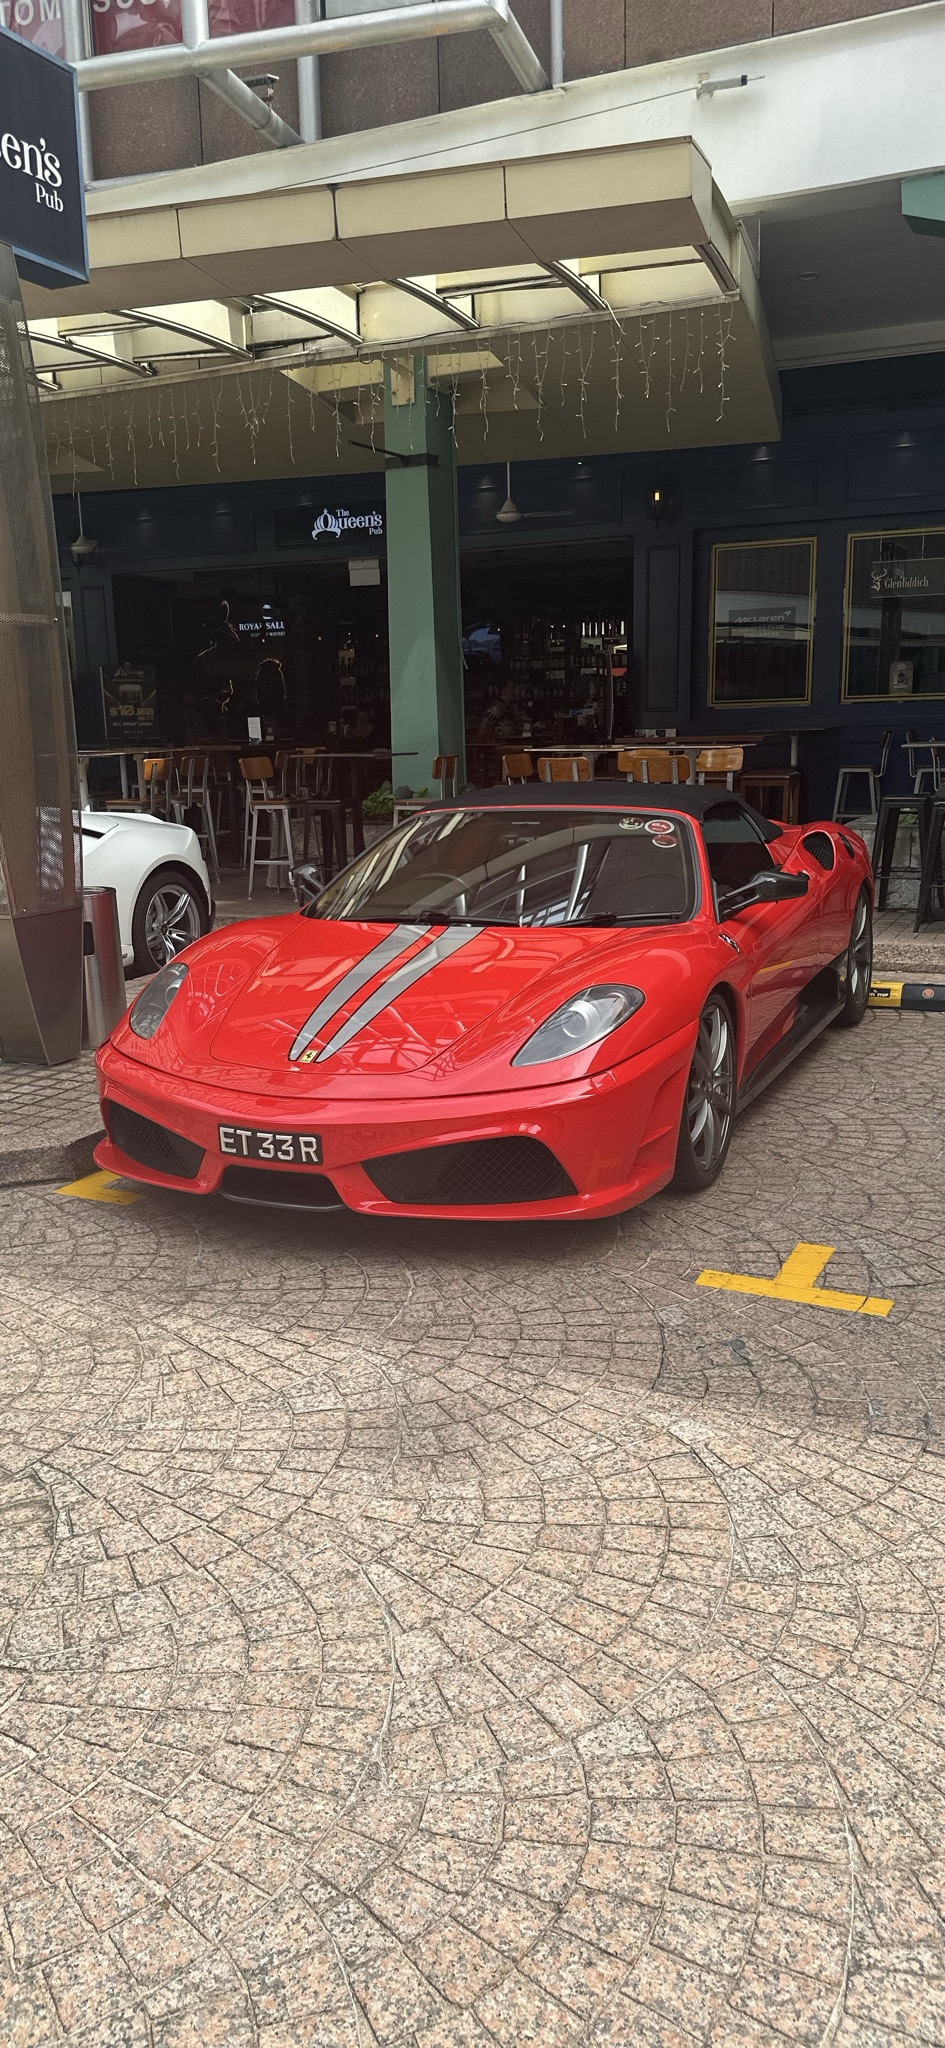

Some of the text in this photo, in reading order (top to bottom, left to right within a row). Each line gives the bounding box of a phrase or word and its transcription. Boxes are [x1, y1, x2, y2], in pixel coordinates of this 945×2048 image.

[0, 133, 62, 187] en's
[35, 182, 64, 212] Pub
[336, 509, 350, 517] The
[312, 508, 383, 540] Queen's
[369, 527, 383, 535] Pub
[884, 576, 929, 589] Glenfiddich
[734, 615, 785, 623] McLaren
